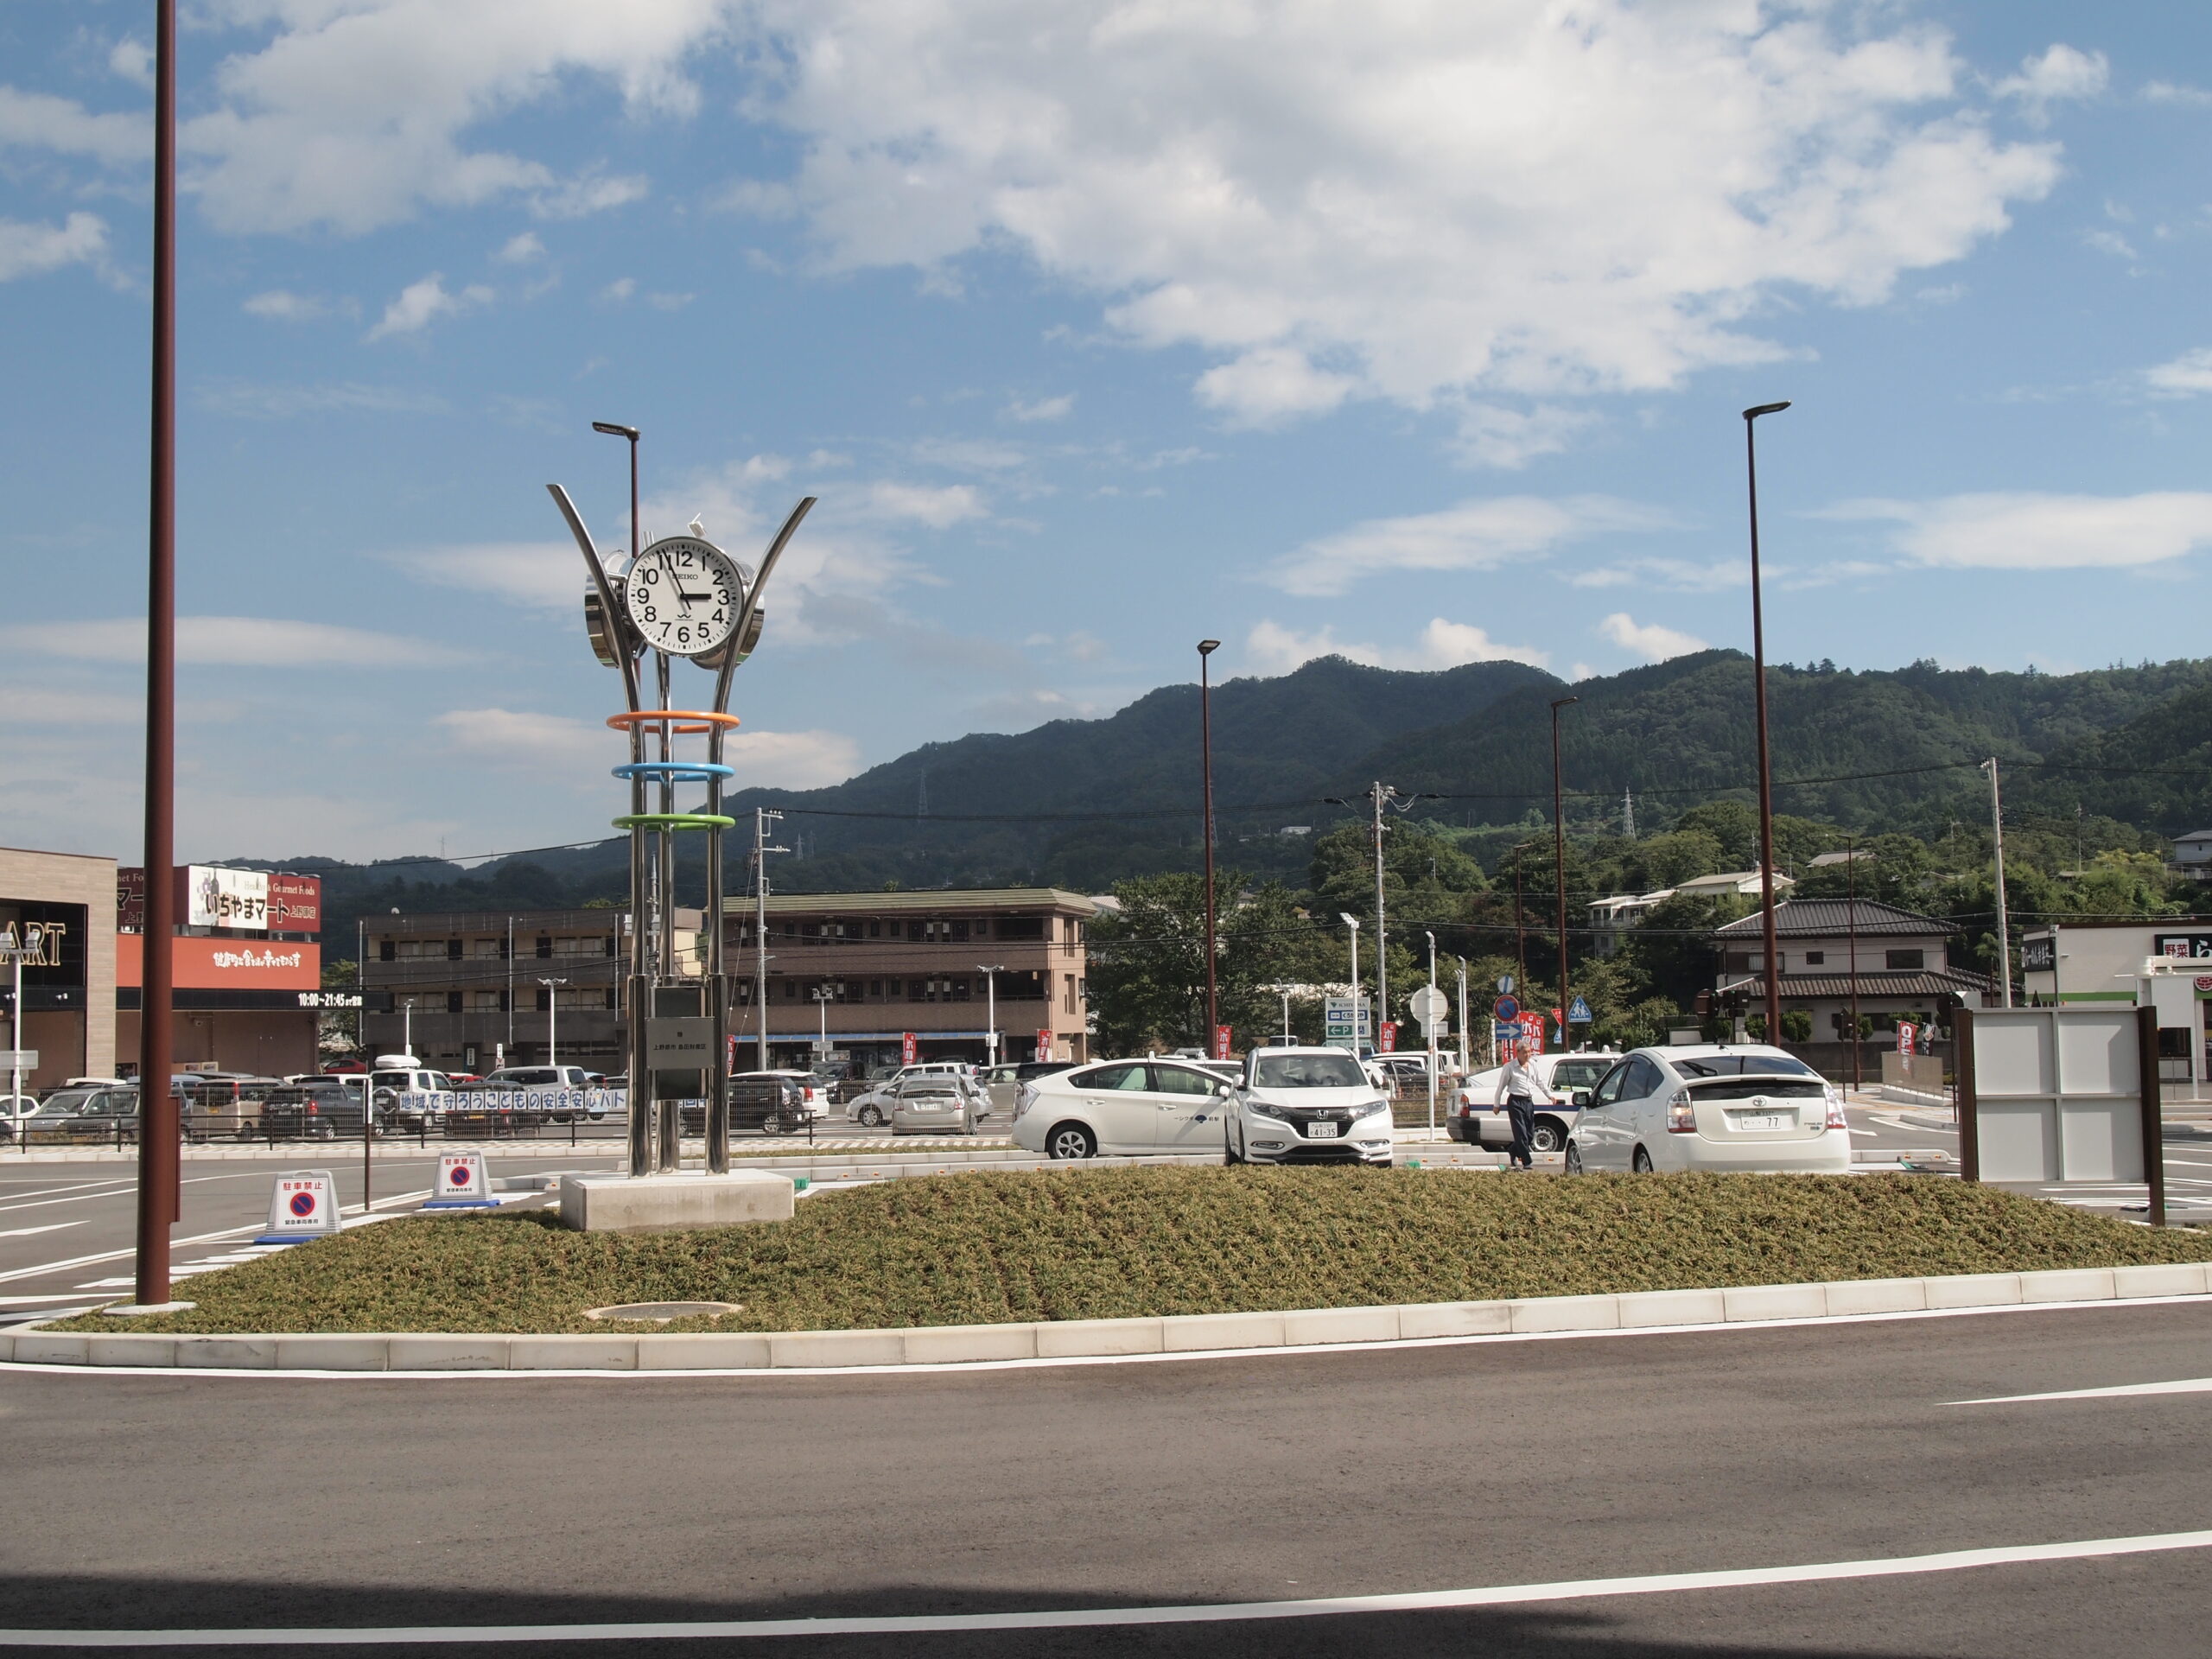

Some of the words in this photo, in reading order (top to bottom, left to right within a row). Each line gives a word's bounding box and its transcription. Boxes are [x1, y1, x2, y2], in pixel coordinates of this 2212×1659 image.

[677, 550, 693, 567] 12
[642, 568, 659, 585] 10
[712, 569, 724, 585] 2
[637, 588, 649, 604] 9
[717, 588, 729, 606] 3
[644, 606, 657, 622] 8
[711, 607, 724, 624] 4
[659, 622, 671, 638] 7
[677, 626, 690, 643] 6
[697, 622, 709, 639] 5
[205, 893, 290, 924] いちやまマート
[1342, 1026, 1350, 1035] P
[1314, 1128, 1336, 1136] 41-35
[283, 1182, 322, 1192] 駐車禁止
